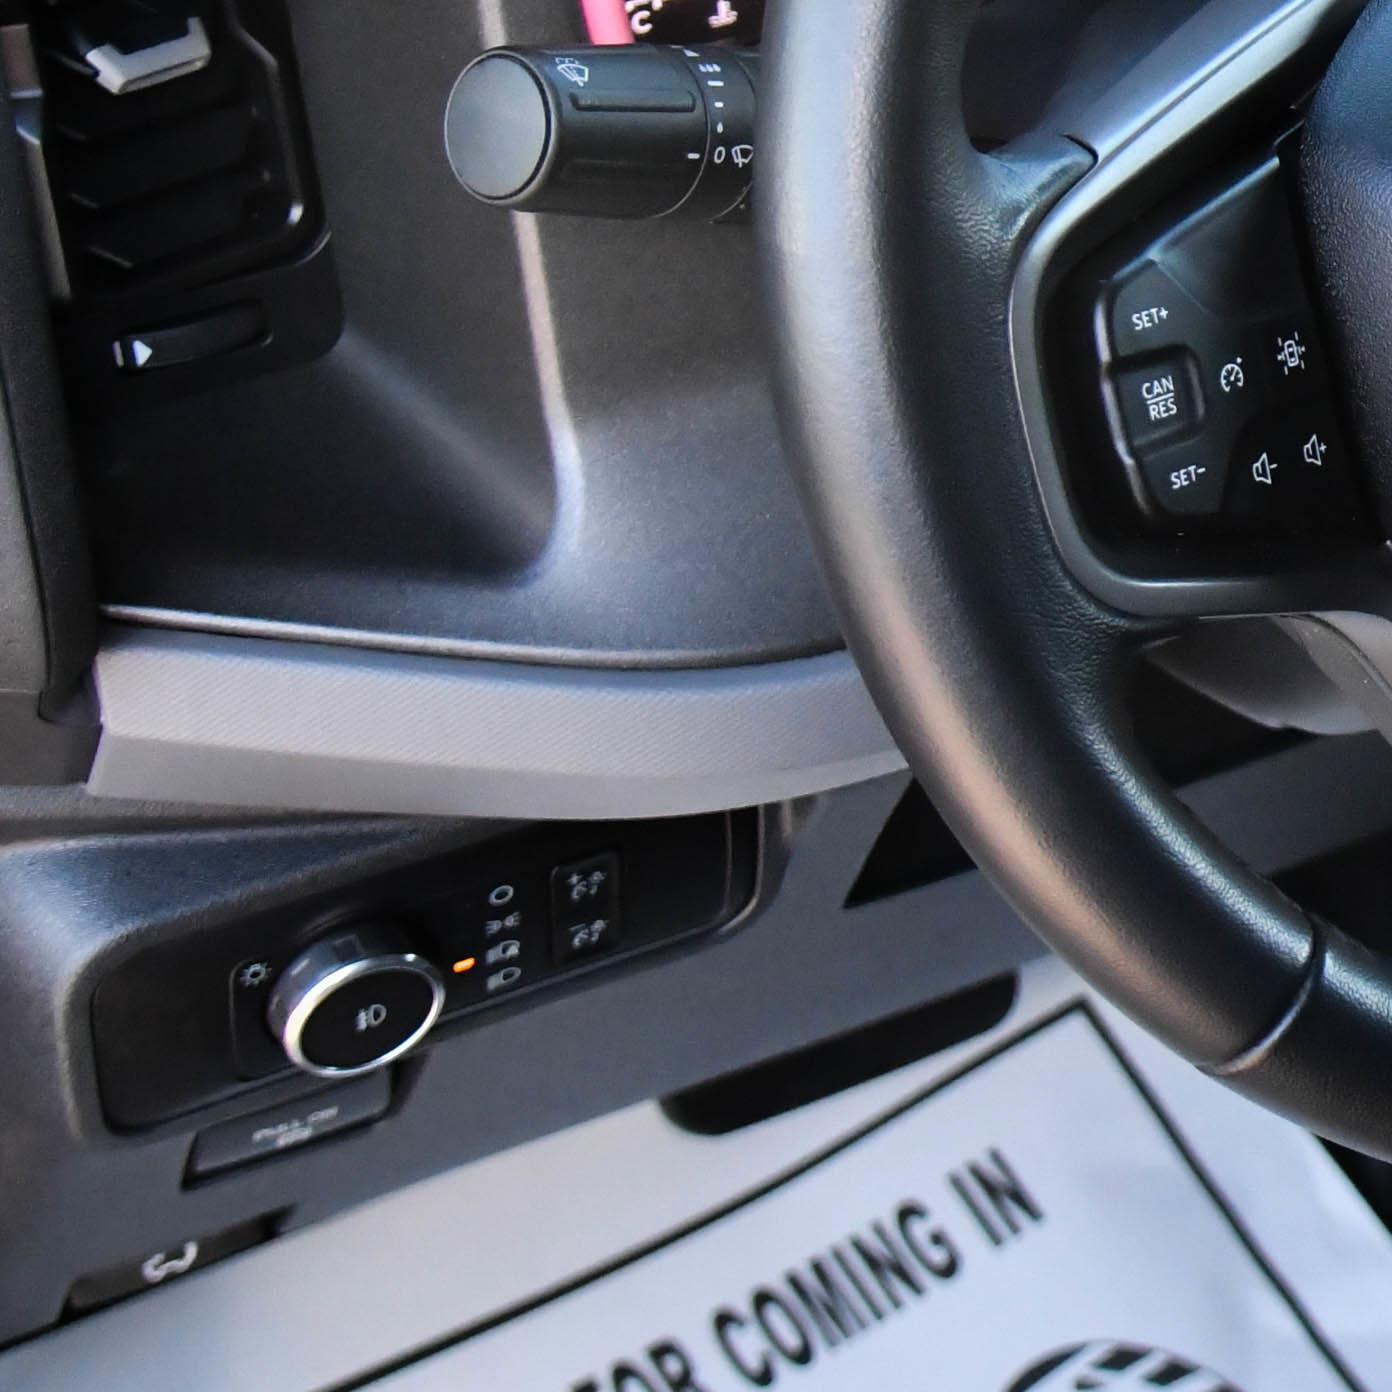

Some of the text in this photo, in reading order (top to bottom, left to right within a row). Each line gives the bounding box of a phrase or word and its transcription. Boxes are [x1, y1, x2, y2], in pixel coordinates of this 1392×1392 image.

[631, 10, 653, 34] C
[1131, 307, 1169, 330] SET+
[1141, 376, 1174, 399] CAN
[1148, 398, 1177, 421] RES
[1170, 464, 1206, 489] SET-
[712, 1147, 1043, 1386] COMING IN
